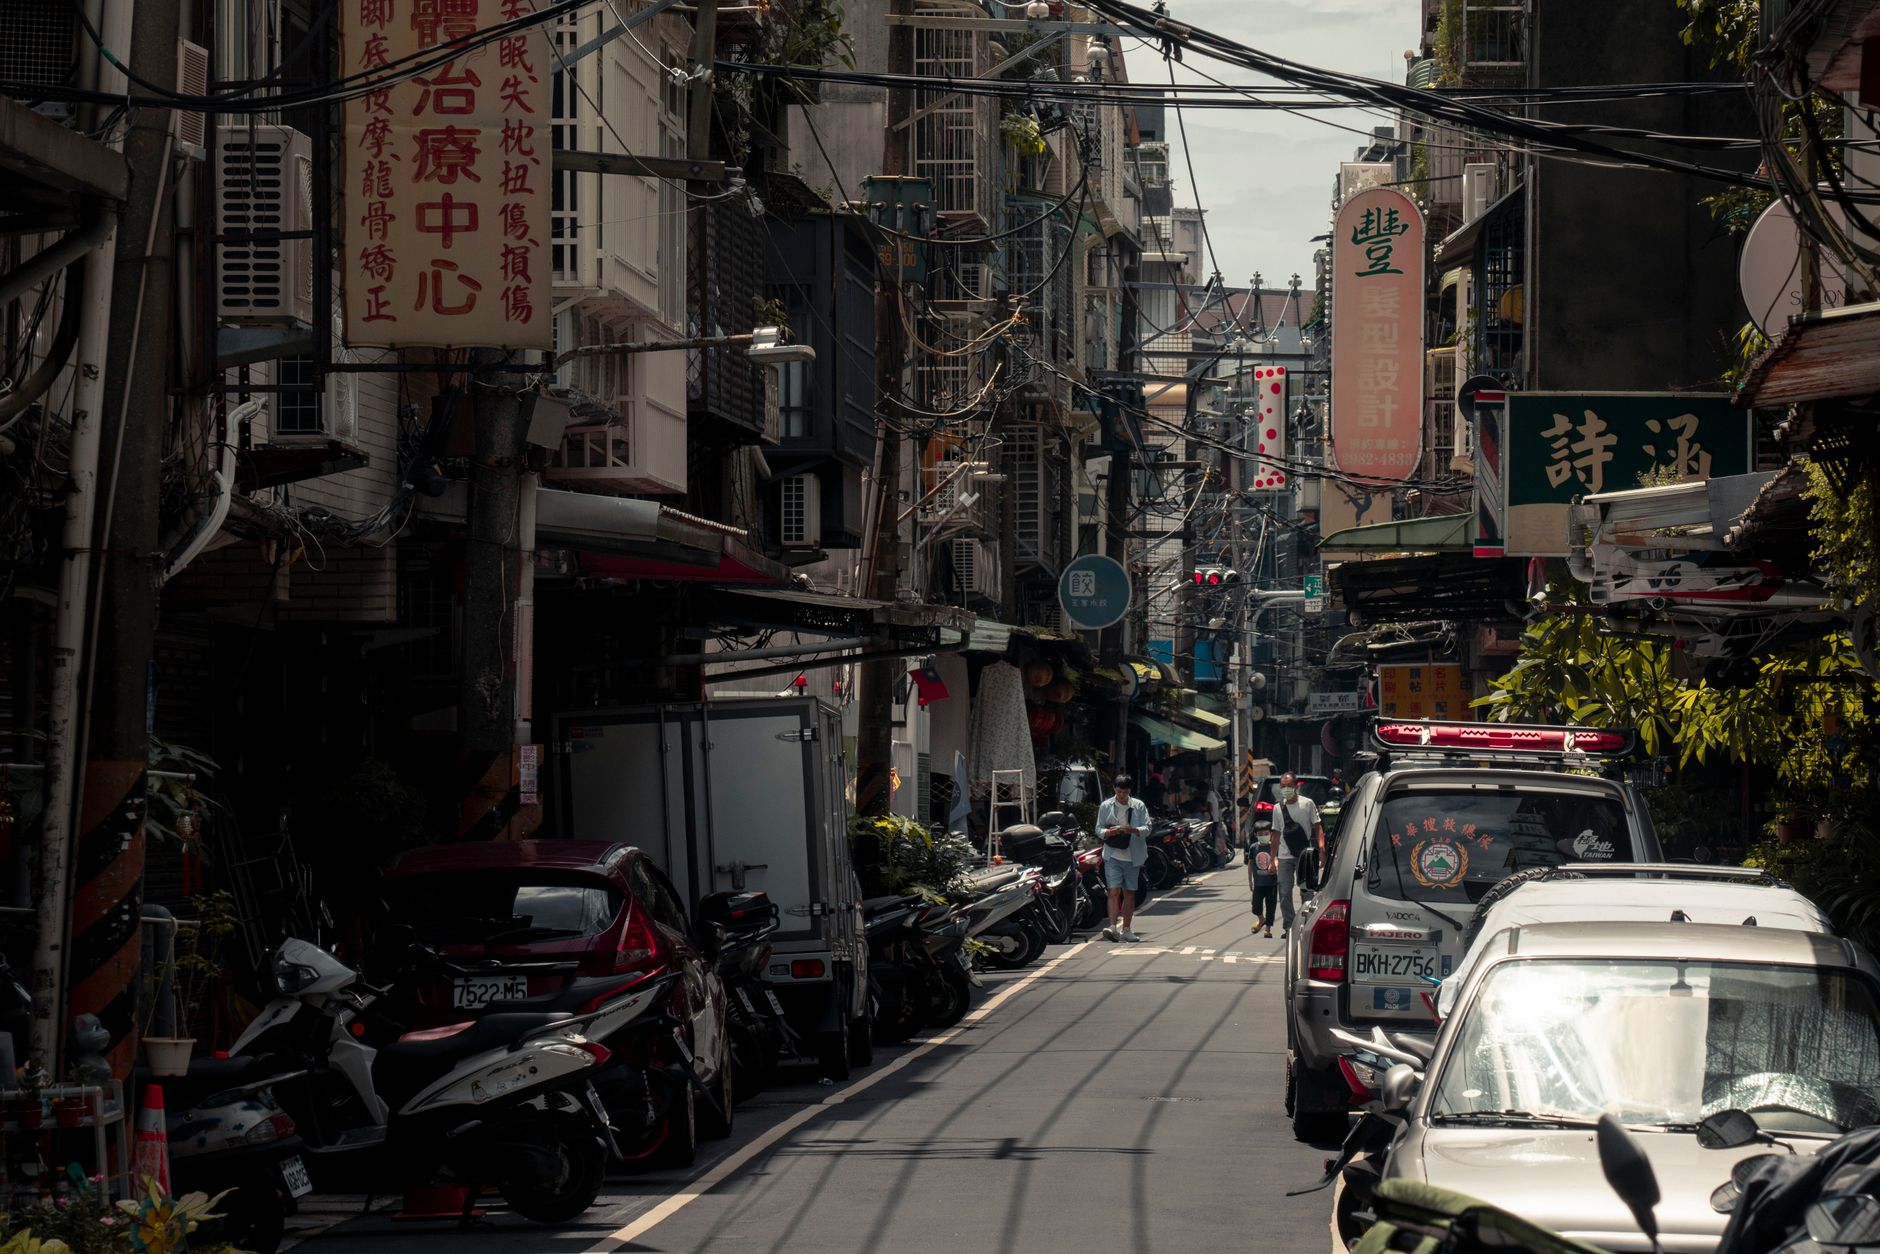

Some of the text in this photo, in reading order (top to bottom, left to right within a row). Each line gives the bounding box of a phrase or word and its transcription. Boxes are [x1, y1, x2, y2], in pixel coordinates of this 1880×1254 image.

[1351, 207, 1409, 277] 豐
[1790, 289, 1848, 306] SON
[1540, 409, 1712, 494] 詩涵
[1071, 572, 1093, 594] 餃
[1370, 931, 1423, 939] PAJERO
